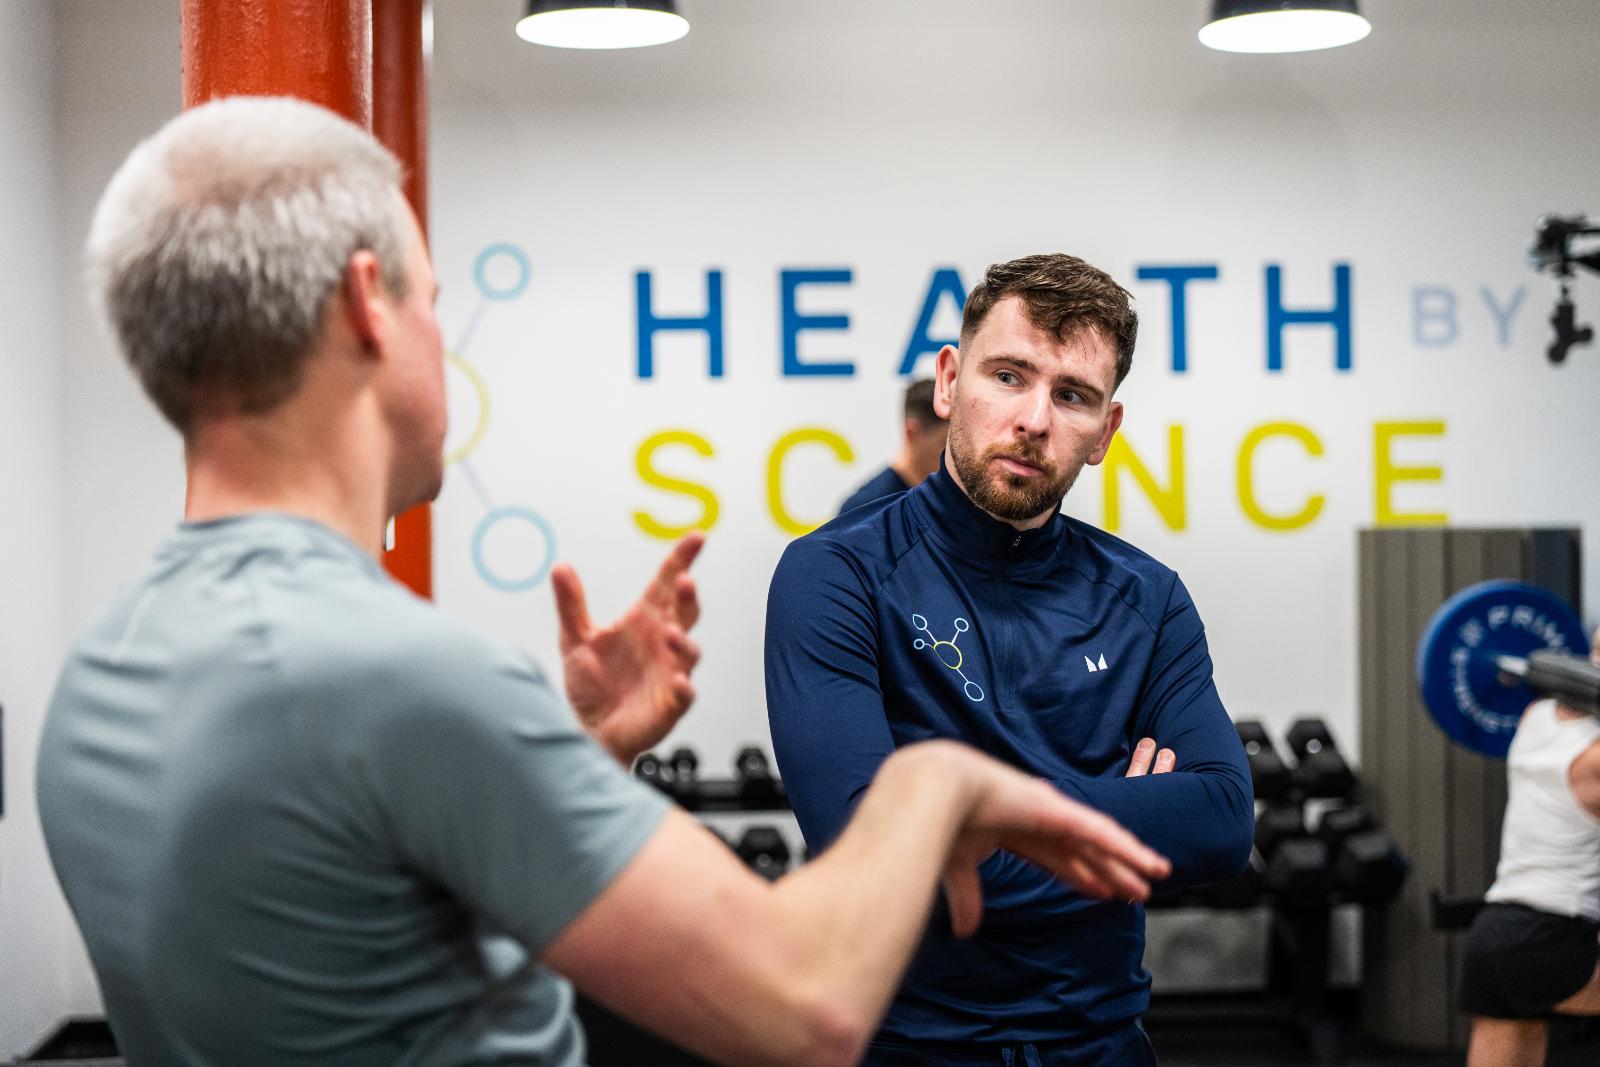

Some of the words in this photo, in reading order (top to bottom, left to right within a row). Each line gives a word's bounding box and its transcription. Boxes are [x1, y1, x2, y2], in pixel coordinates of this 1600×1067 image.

[634, 263, 1353, 379] HEATH
[1411, 286, 1527, 347] BY
[632, 419, 1449, 541] SCNCE
